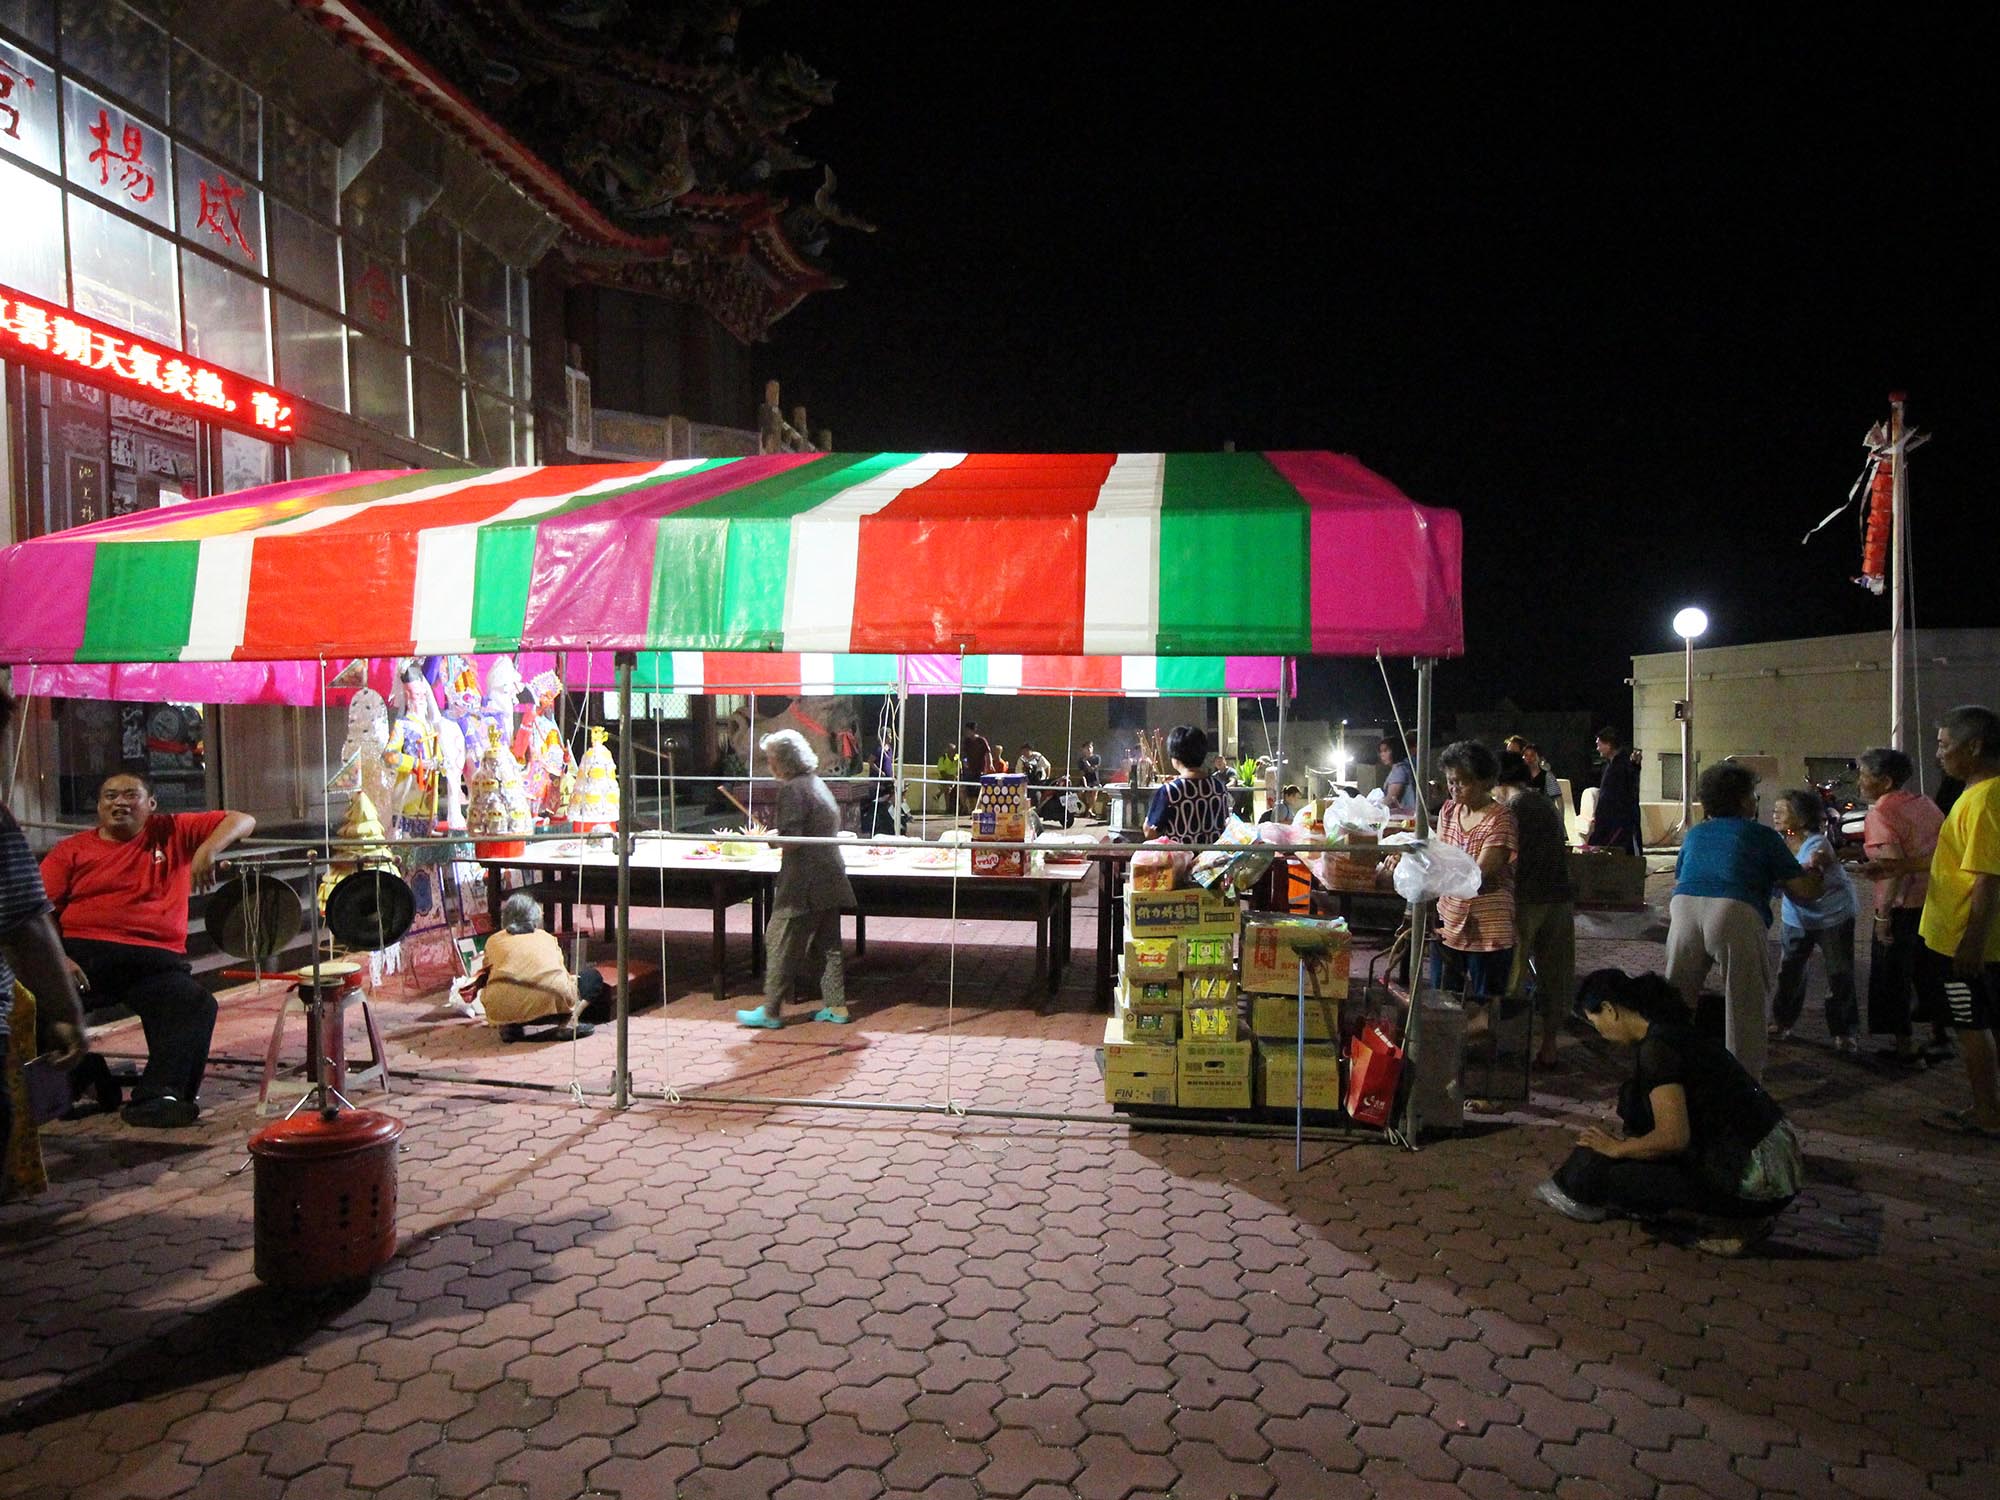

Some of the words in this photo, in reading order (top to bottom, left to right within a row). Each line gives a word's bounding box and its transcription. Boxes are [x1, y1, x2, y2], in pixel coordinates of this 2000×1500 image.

[0, 295, 291, 432] 暑期天氣炎熱，青
